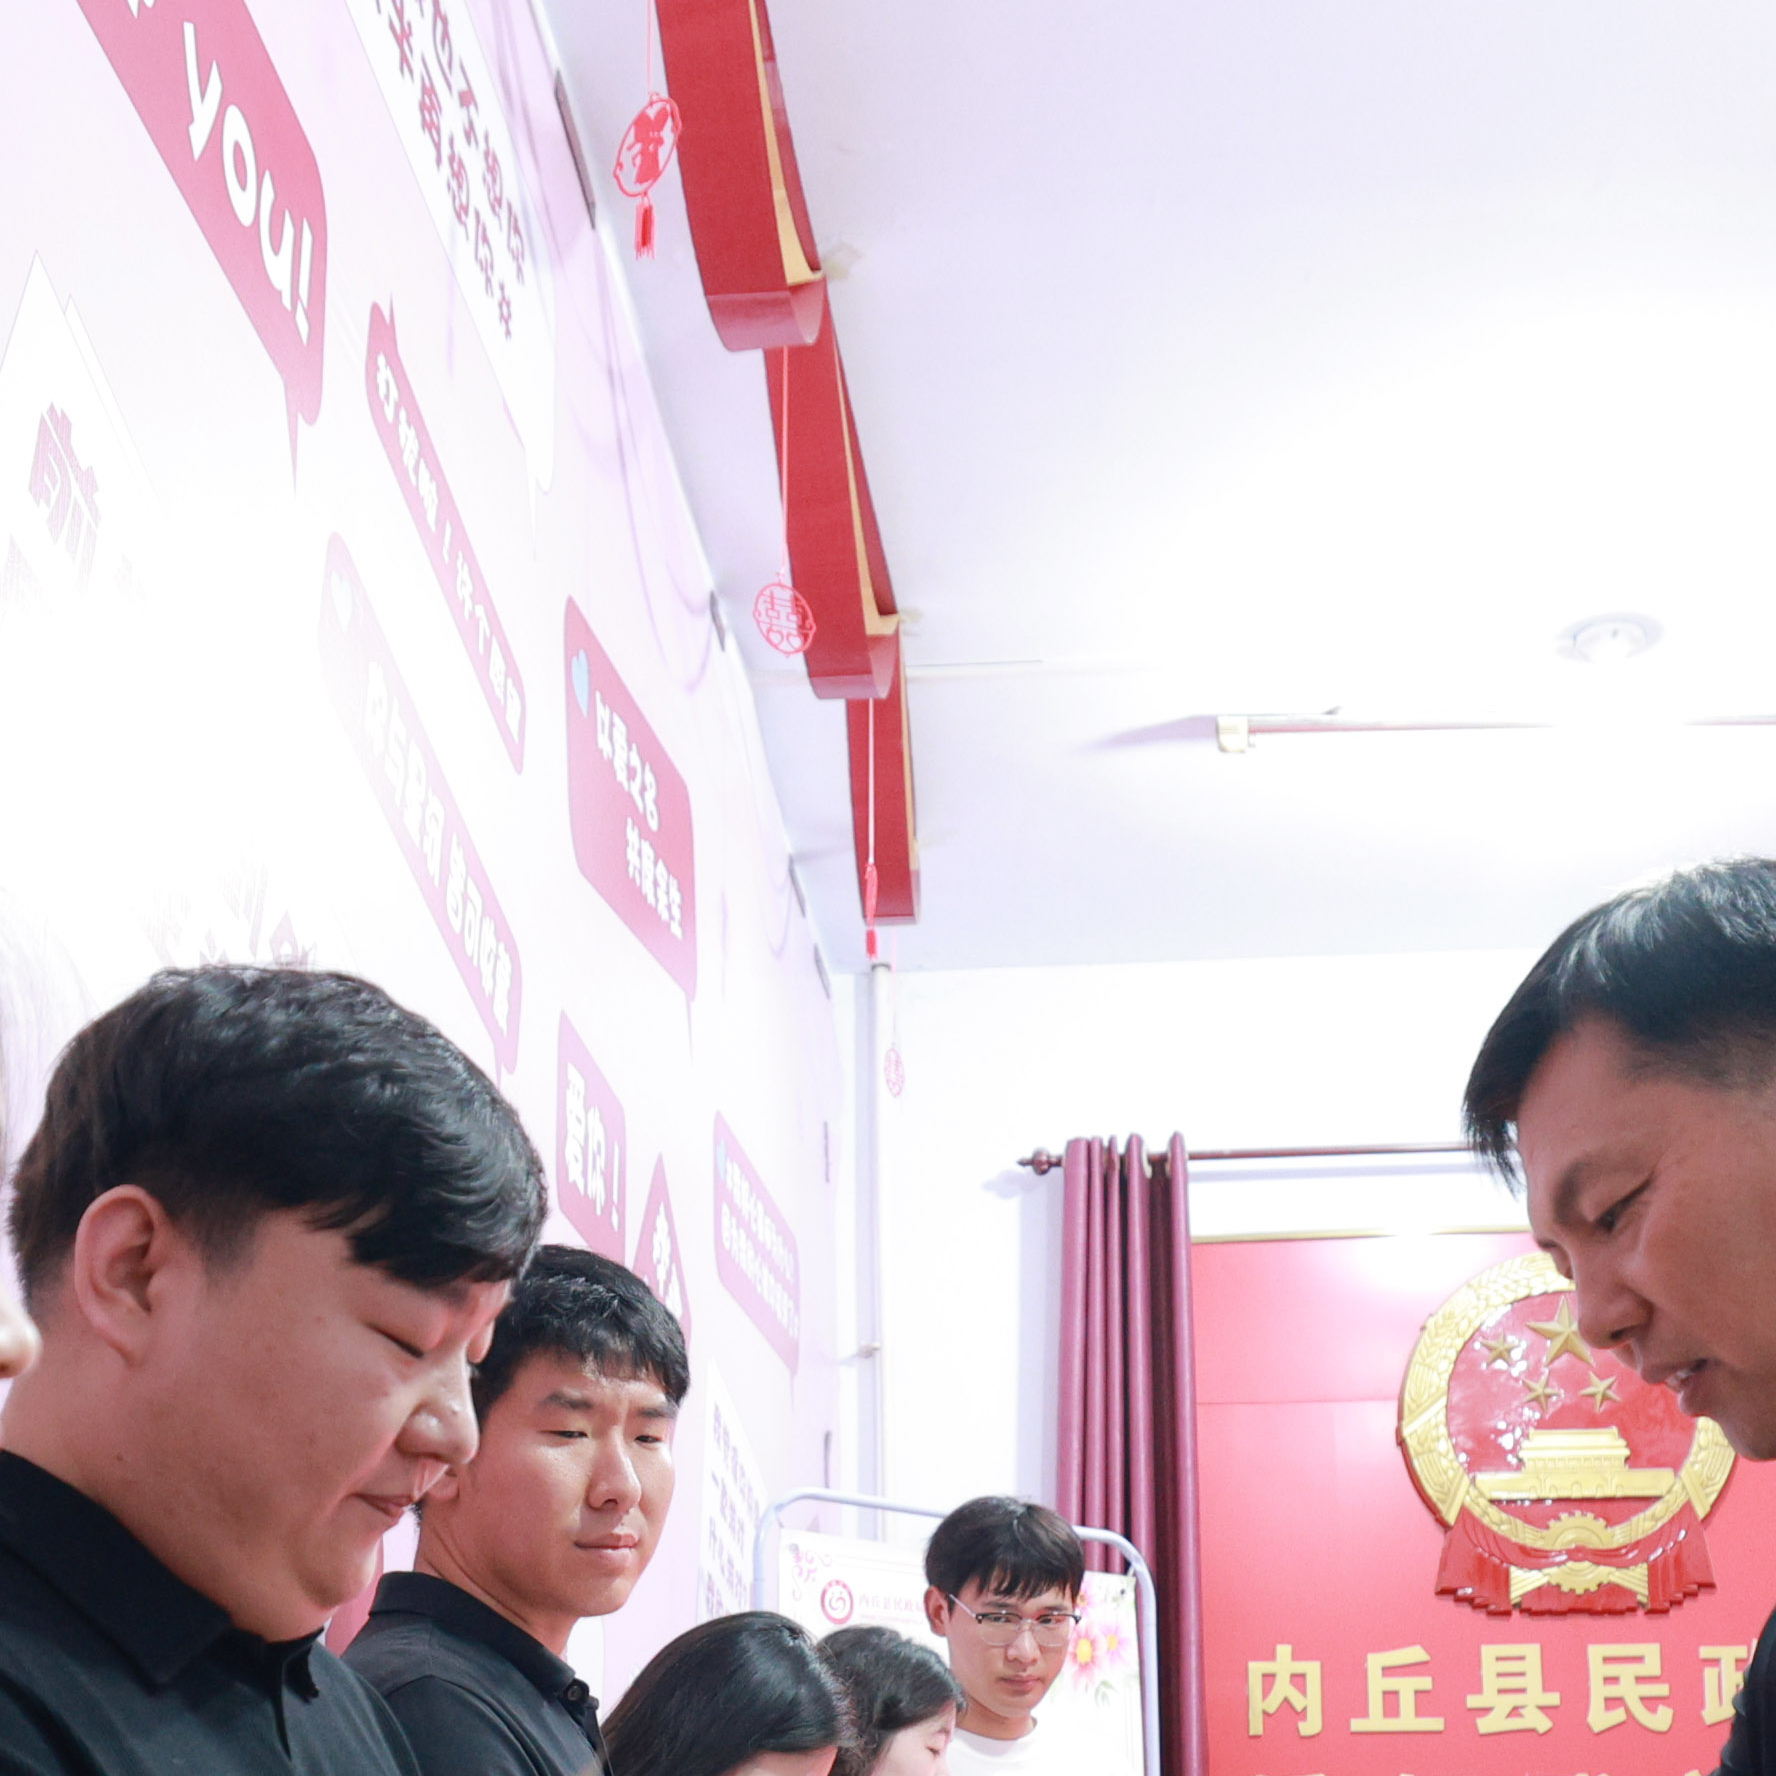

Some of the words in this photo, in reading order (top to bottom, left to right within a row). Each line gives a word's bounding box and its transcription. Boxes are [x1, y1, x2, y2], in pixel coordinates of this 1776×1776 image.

[183, 22, 313, 347] you!
[419, 0, 524, 285] 也不想你
[595, 690, 659, 832] 以爱之名
[626, 816, 683, 940] 共度余生
